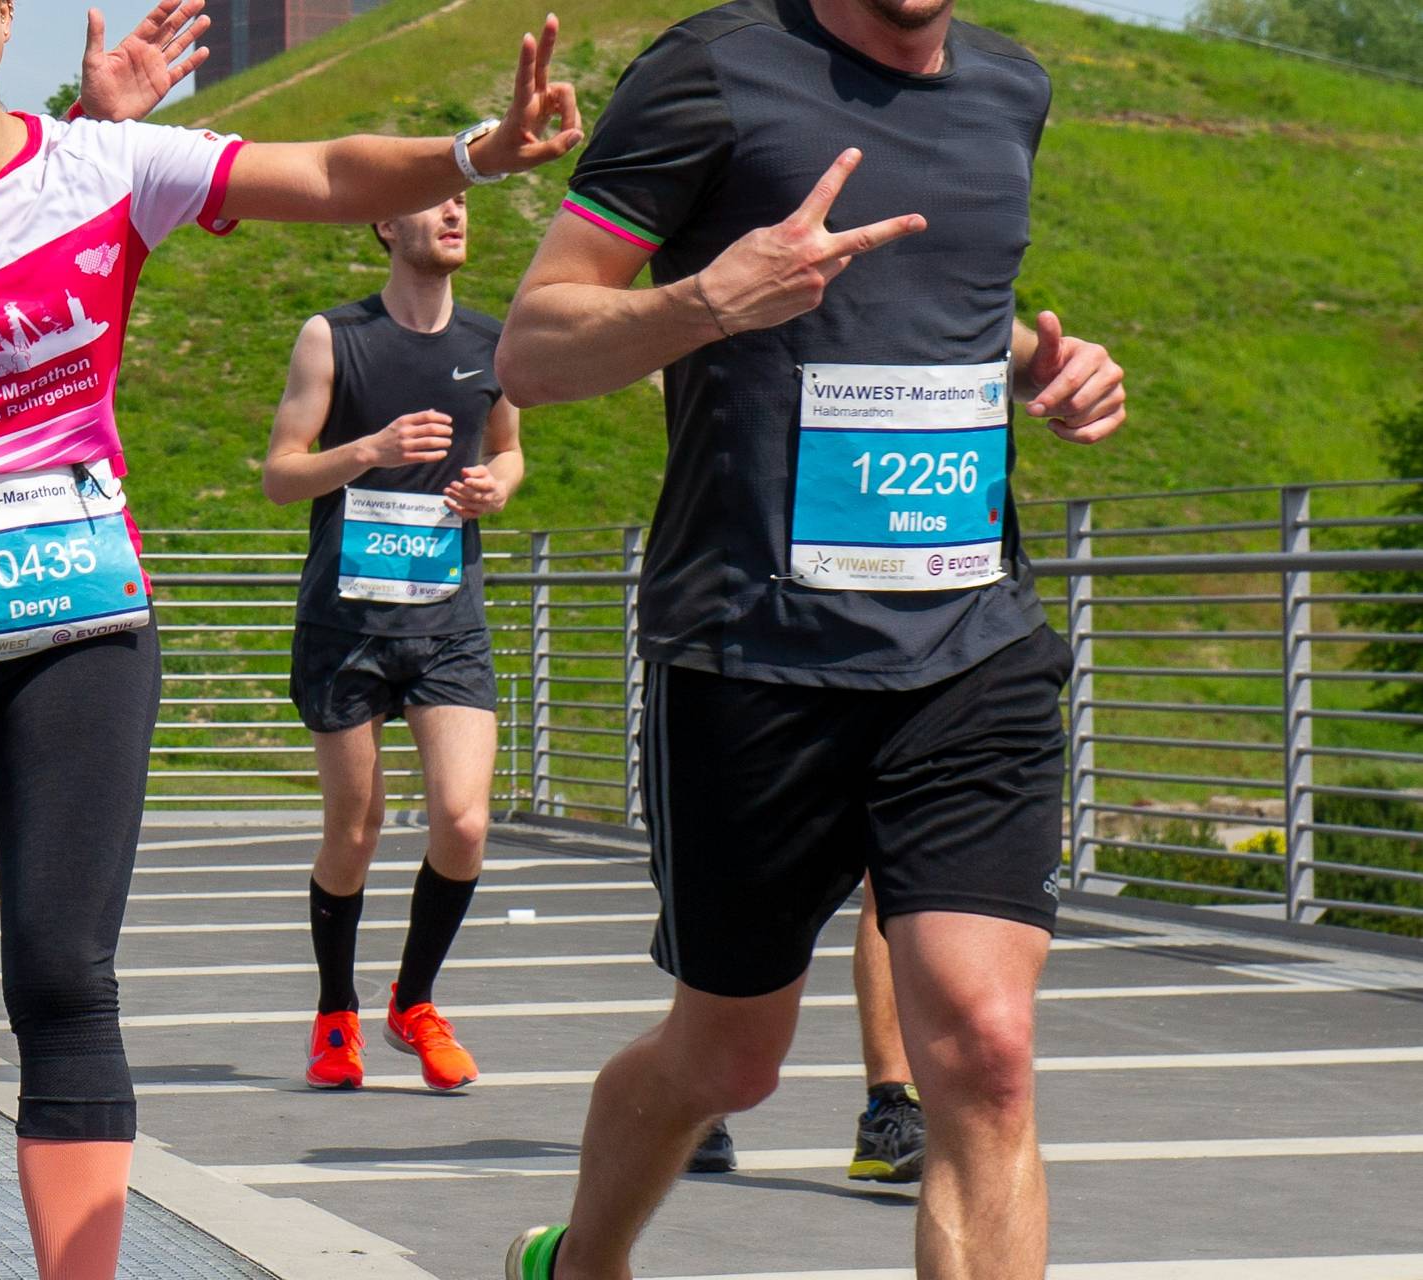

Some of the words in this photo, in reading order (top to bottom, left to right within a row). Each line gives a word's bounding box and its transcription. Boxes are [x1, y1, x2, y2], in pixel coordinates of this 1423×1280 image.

[7, 373, 99, 417] Ruhrgebiet!
[814, 385, 974, 400] VIVAWEST-Marathon
[813, 406, 893, 417] Halbmarathon
[852, 451, 978, 495] 12256
[889, 511, 947, 532] Milos
[366, 532, 439, 558] 25097
[836, 557, 905, 573] VIVAWEST
[9, 595, 71, 619] Derya
